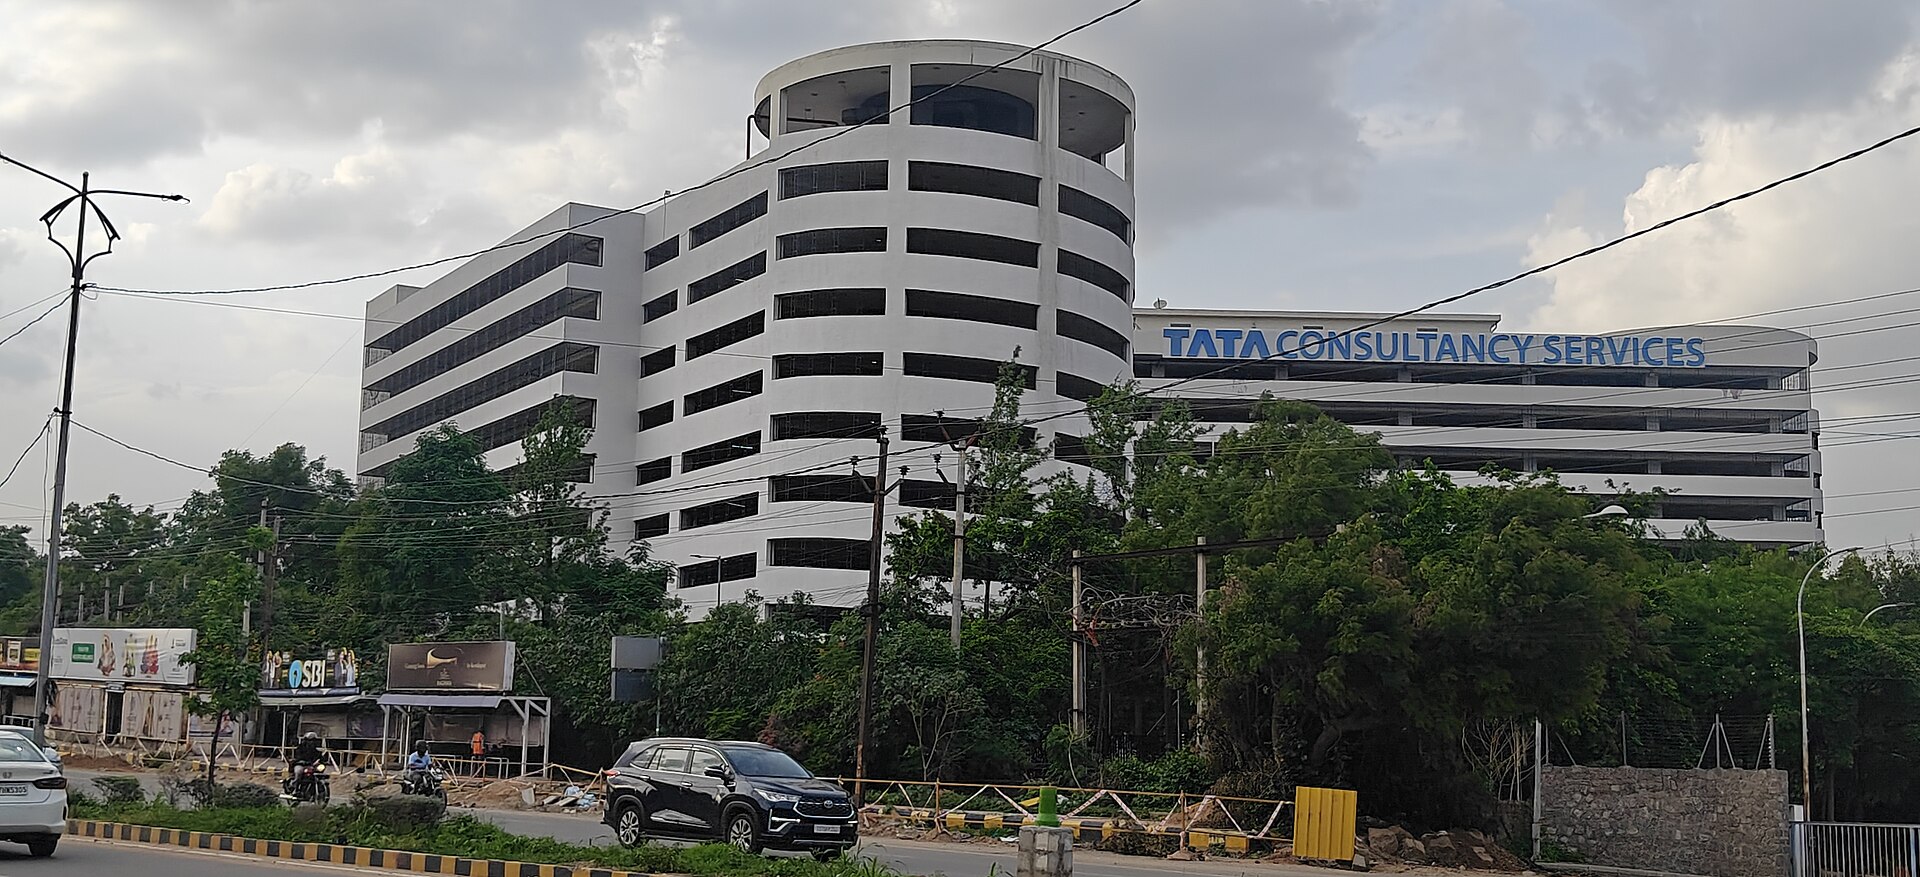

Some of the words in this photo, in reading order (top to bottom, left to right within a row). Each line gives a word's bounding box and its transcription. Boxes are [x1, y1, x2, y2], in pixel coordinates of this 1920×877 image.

[1163, 328, 1271, 359] TATA
[1276, 331, 1534, 363] CONSULTANCY
[1543, 336, 1706, 367] SERVICES
[302, 660, 326, 688] SBI
